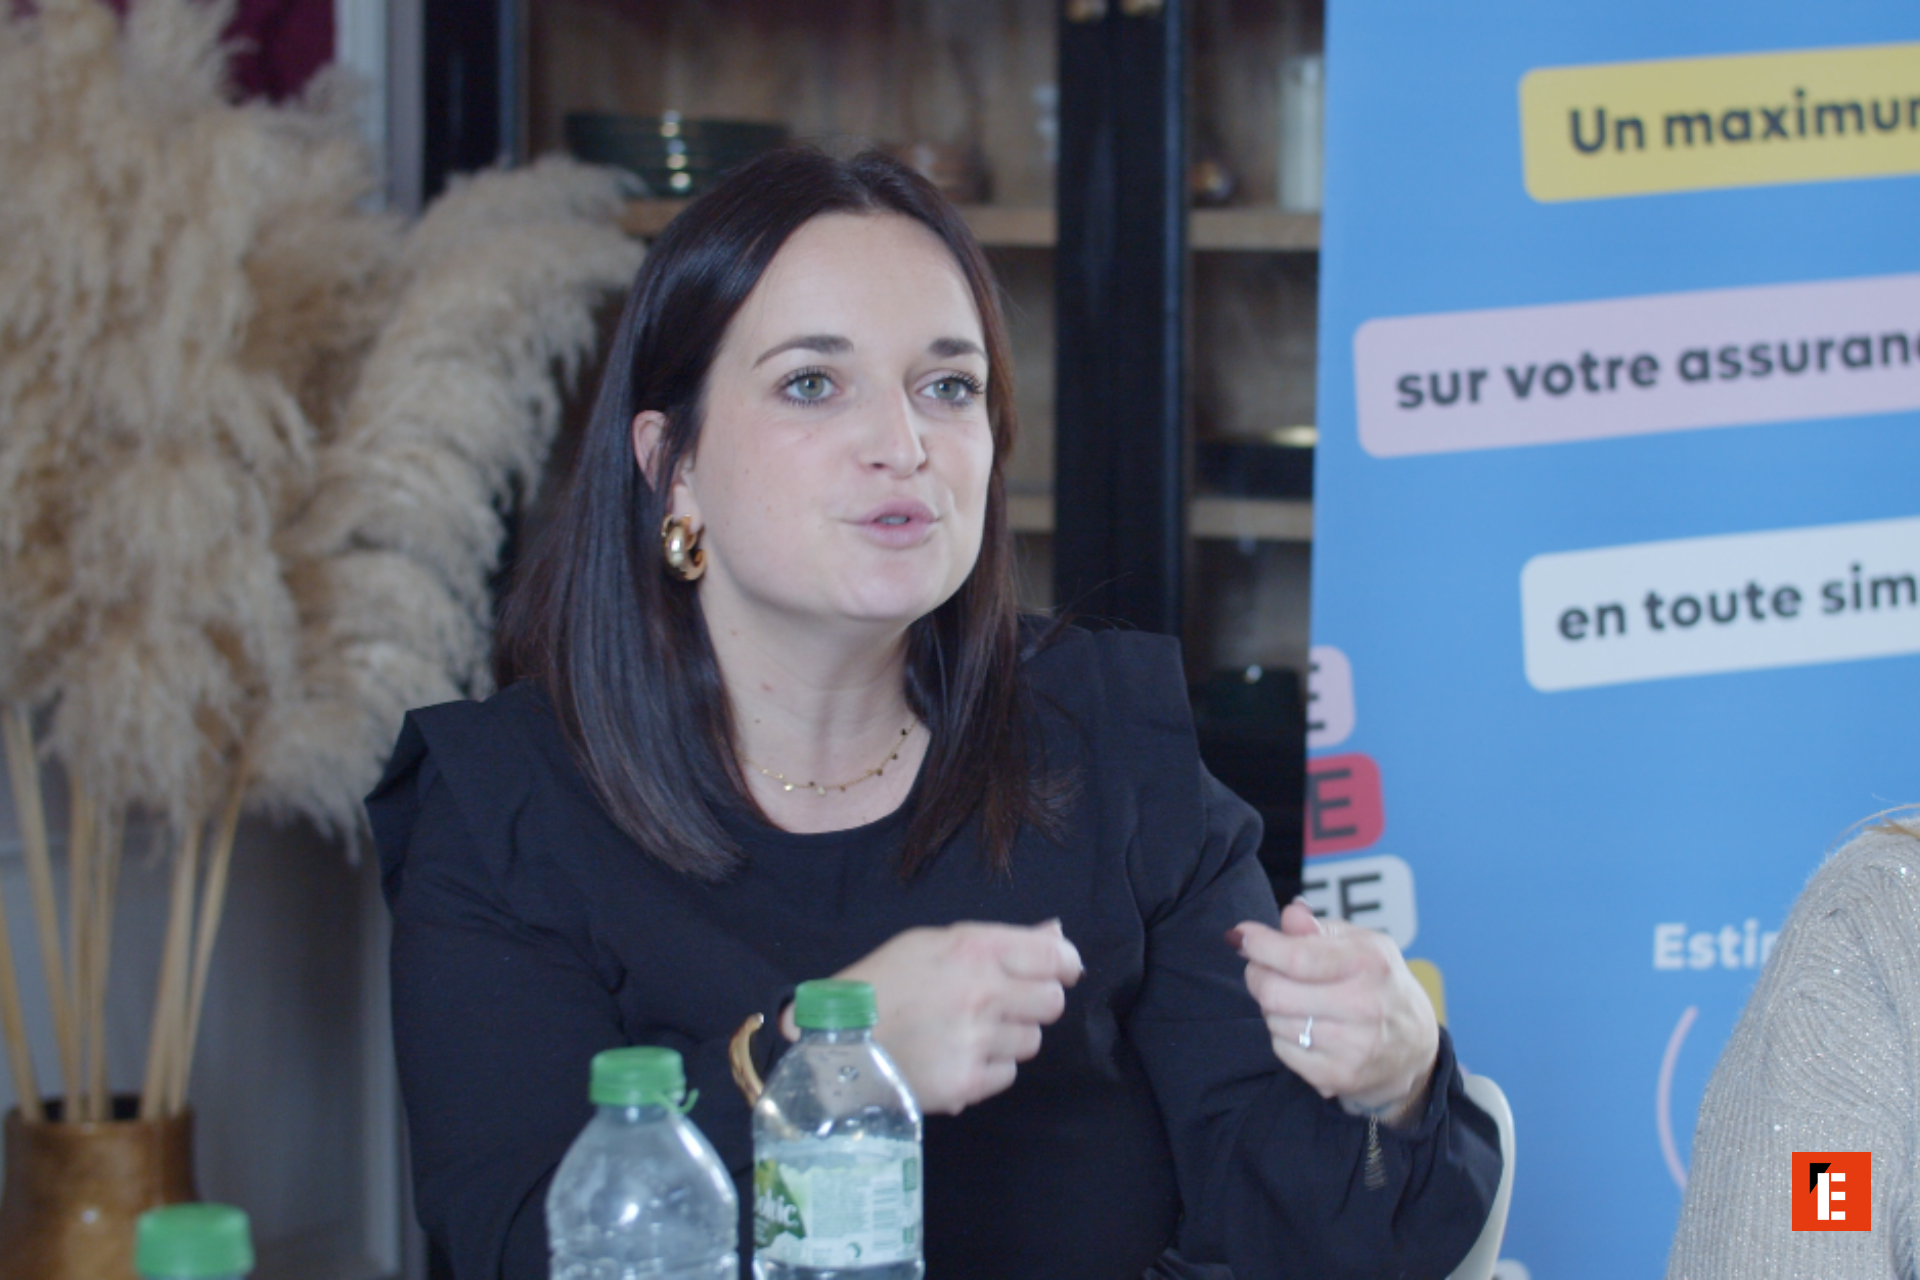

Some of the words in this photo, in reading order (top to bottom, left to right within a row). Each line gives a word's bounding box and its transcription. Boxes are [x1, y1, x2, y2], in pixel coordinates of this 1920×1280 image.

[1569, 107, 1646, 155] Un
[1663, 88, 1920, 149] maximu
[1396, 368, 1488, 410] sur
[1504, 350, 1660, 401] votre
[1677, 331, 1920, 385] assuran
[1558, 602, 1626, 641] en
[1643, 580, 1803, 632] toute
